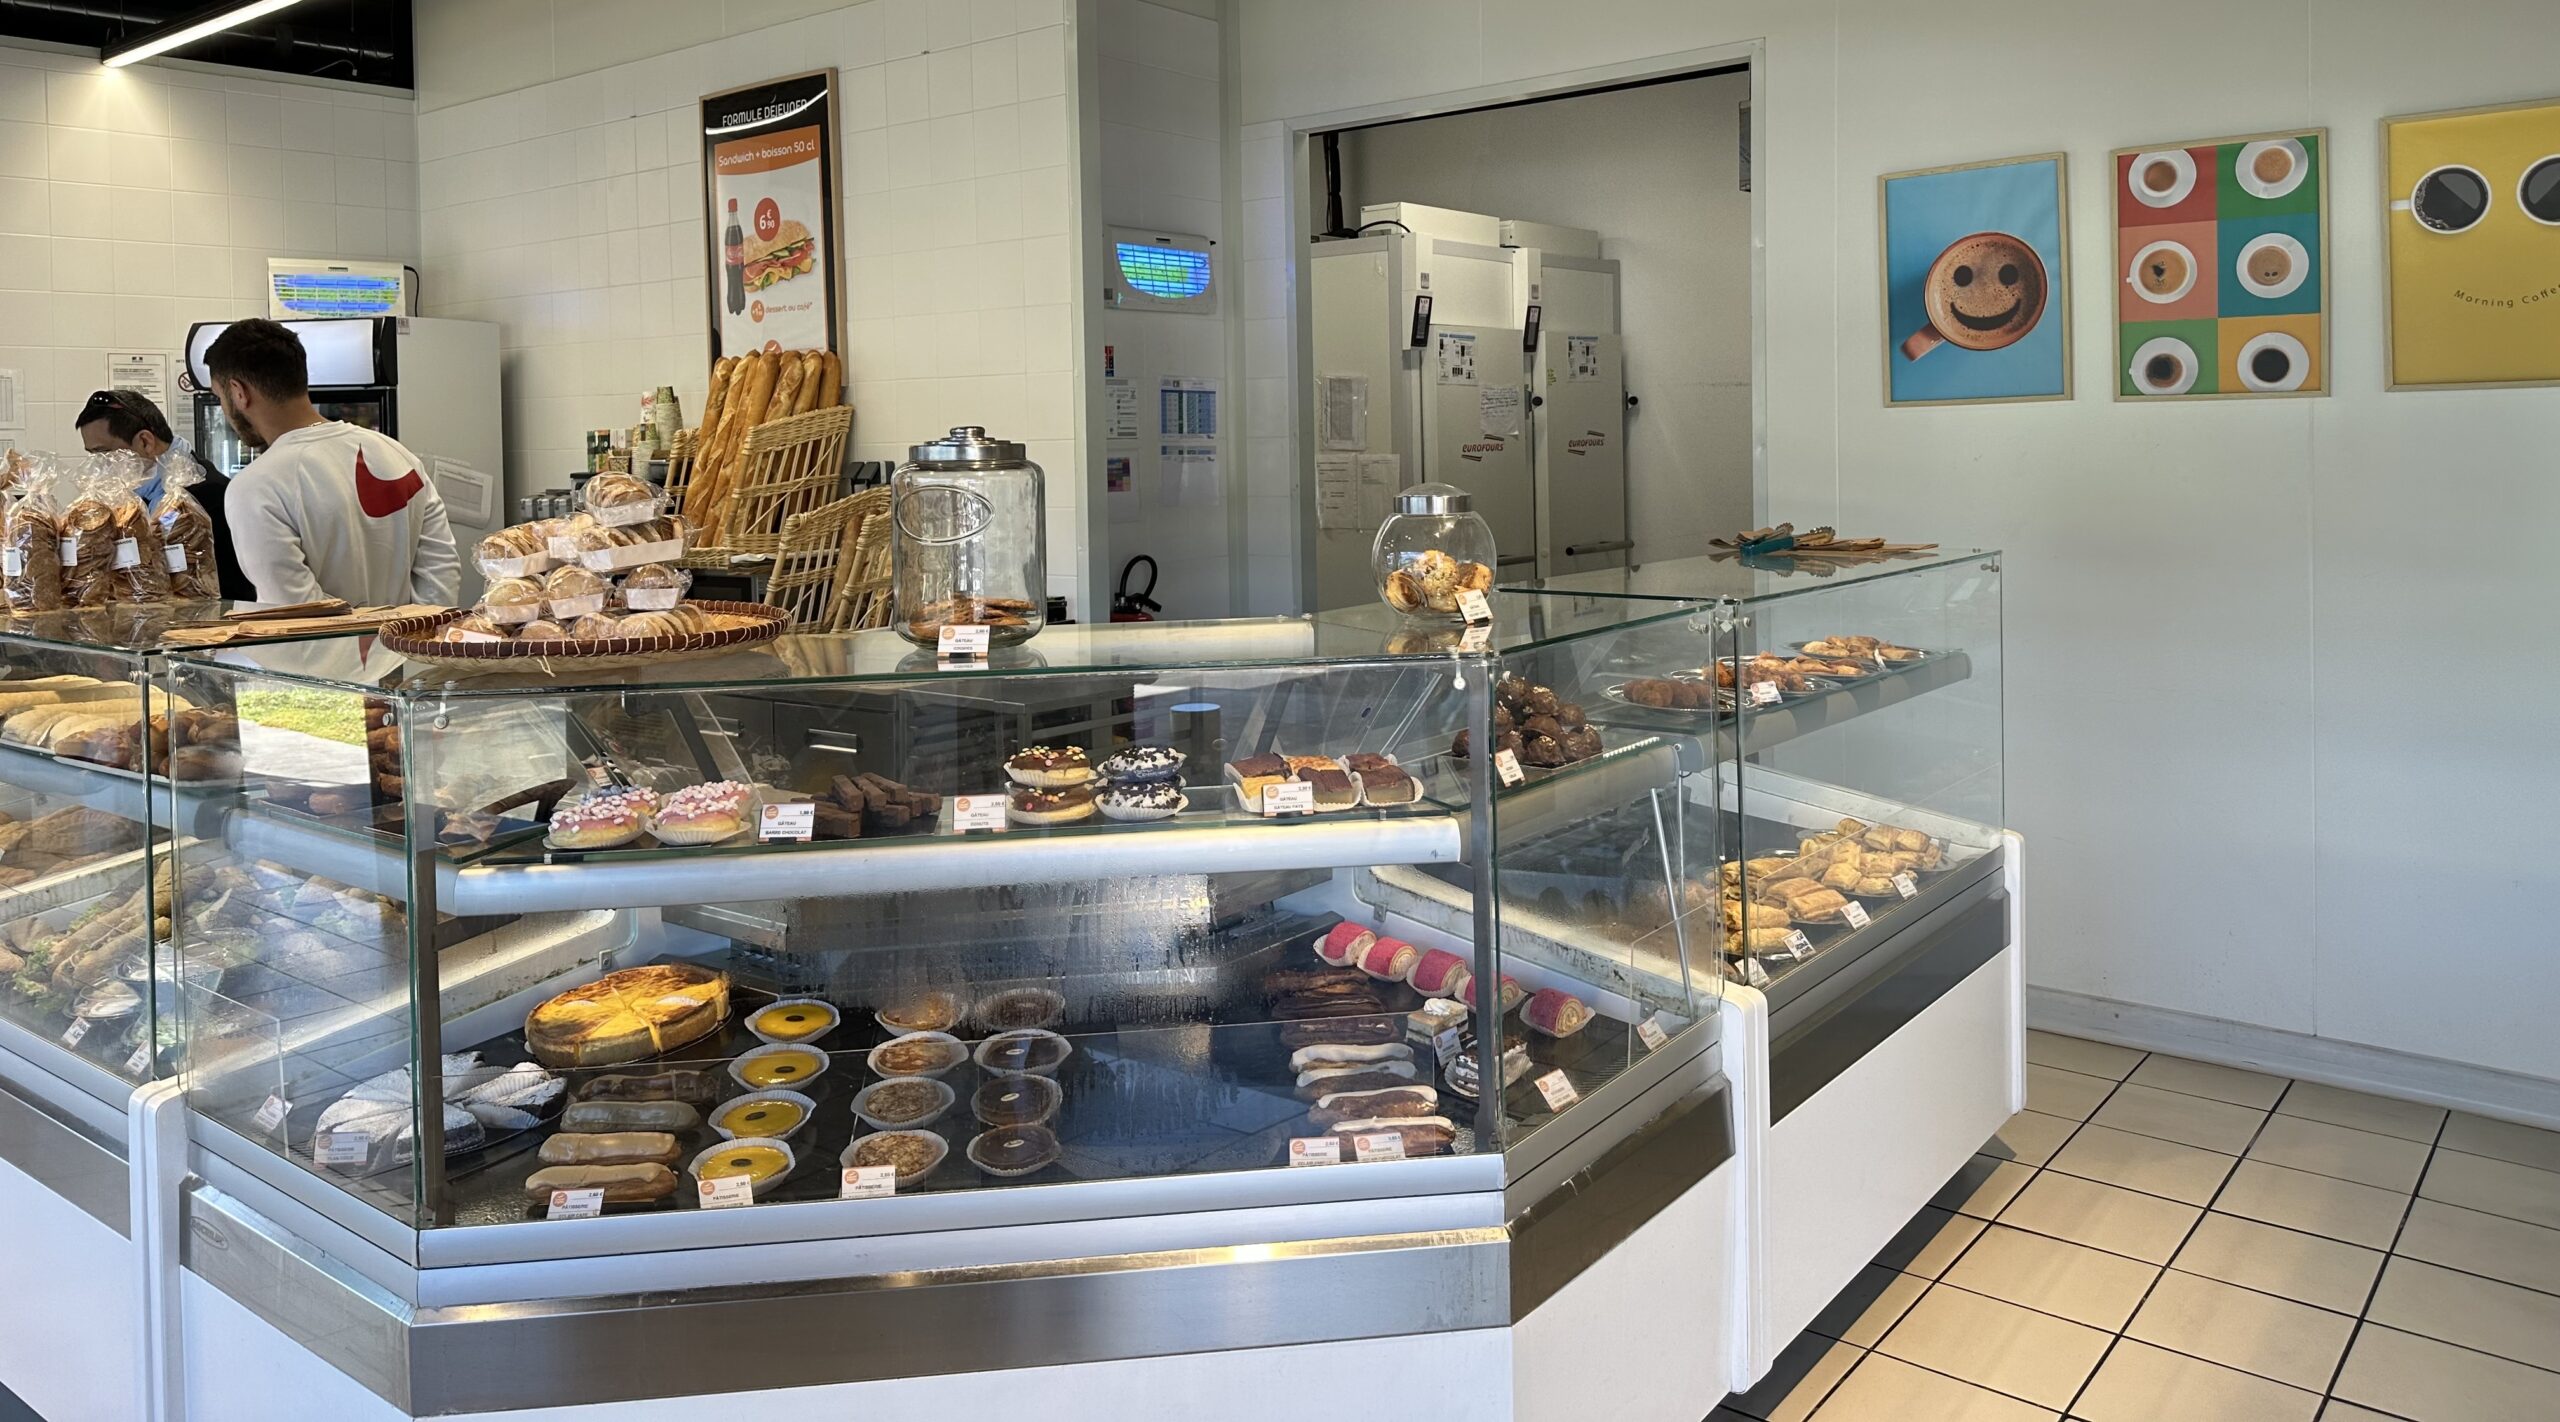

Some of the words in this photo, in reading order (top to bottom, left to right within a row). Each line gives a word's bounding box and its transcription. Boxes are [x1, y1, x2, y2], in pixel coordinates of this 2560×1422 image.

[722, 107, 763, 128] FORMULE
[718, 151, 755, 168] Sandwich
[761, 146, 793, 159] boisson
[793, 140, 805, 153] 50
[806, 138, 816, 152] cl
[2453, 289, 2514, 309] Morning
[2521, 284, 2560, 304] Coffe
